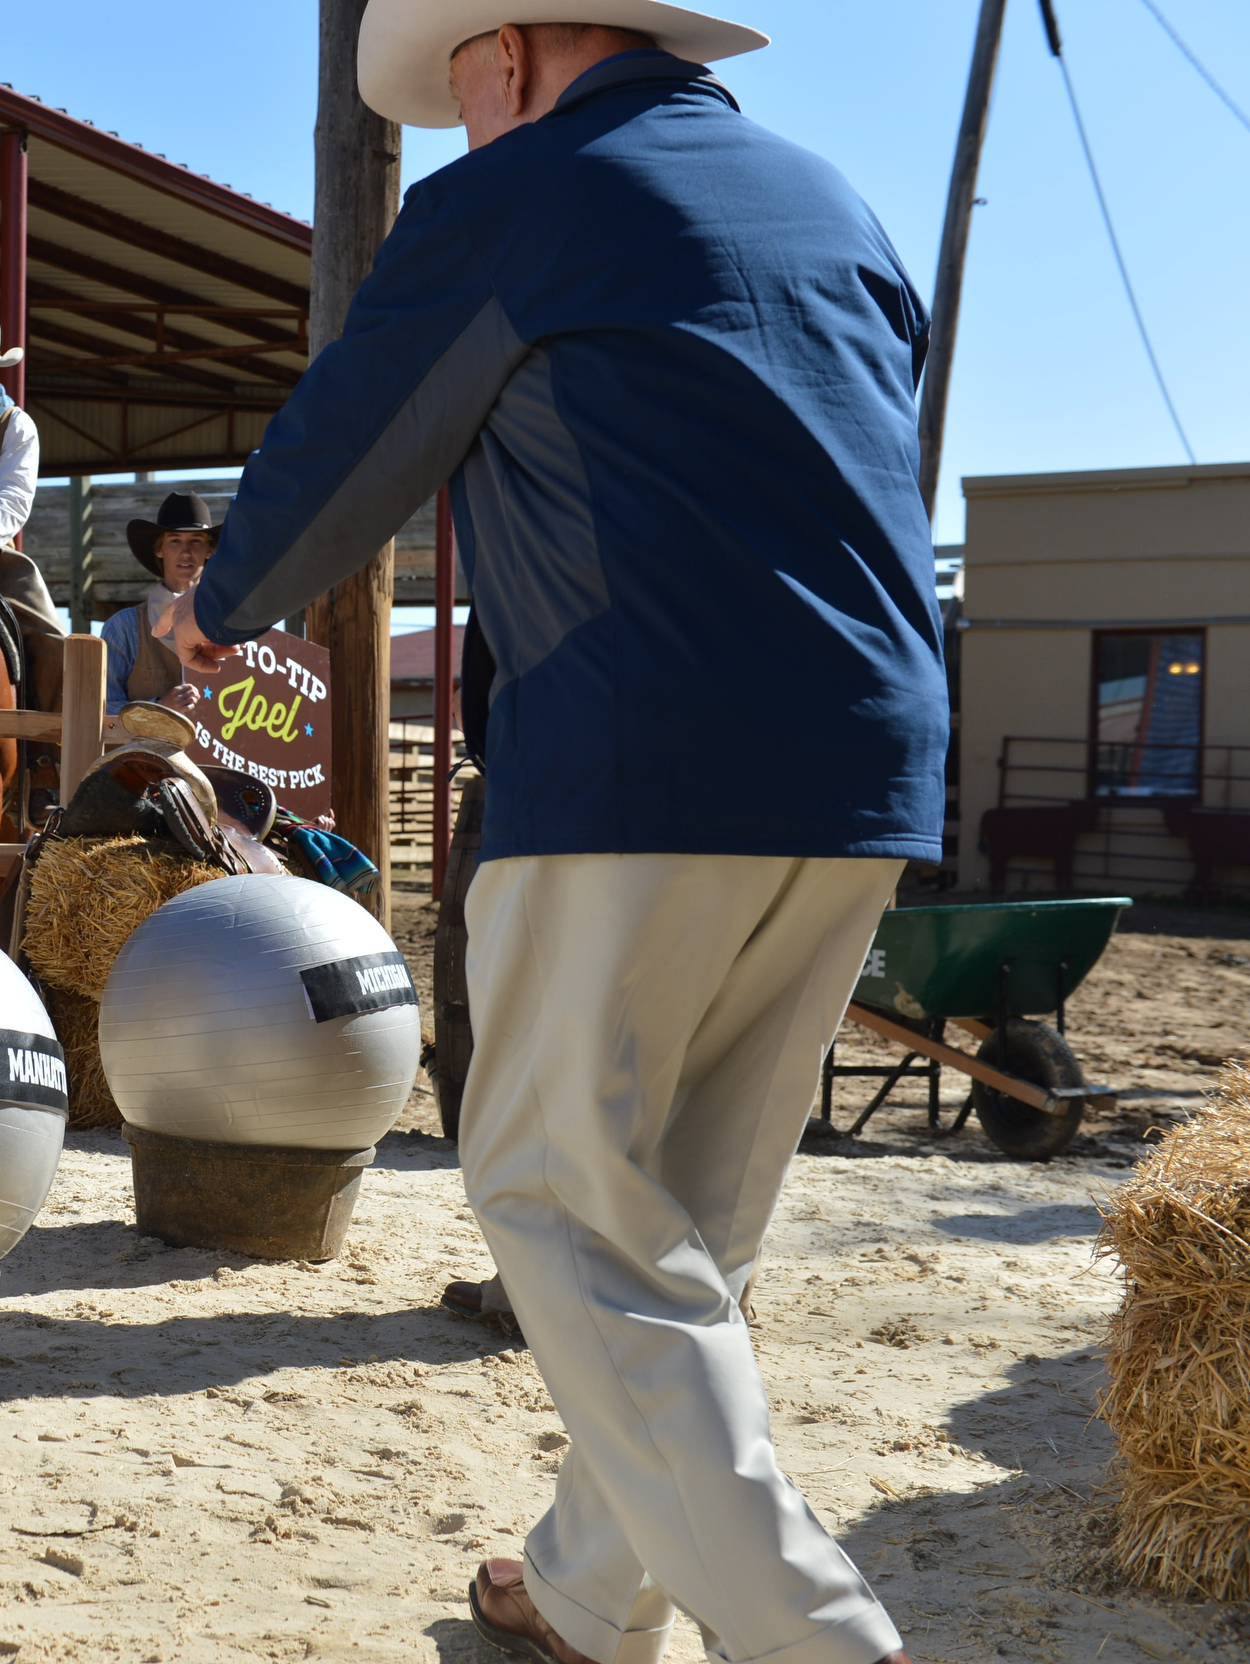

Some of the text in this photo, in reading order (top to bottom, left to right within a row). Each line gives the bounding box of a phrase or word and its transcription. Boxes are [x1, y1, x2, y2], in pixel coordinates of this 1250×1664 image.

[218, 676, 302, 742] Joel
[212, 738, 245, 773] THE
[248, 761, 288, 789] BEST
[289, 763, 326, 789] PICK
